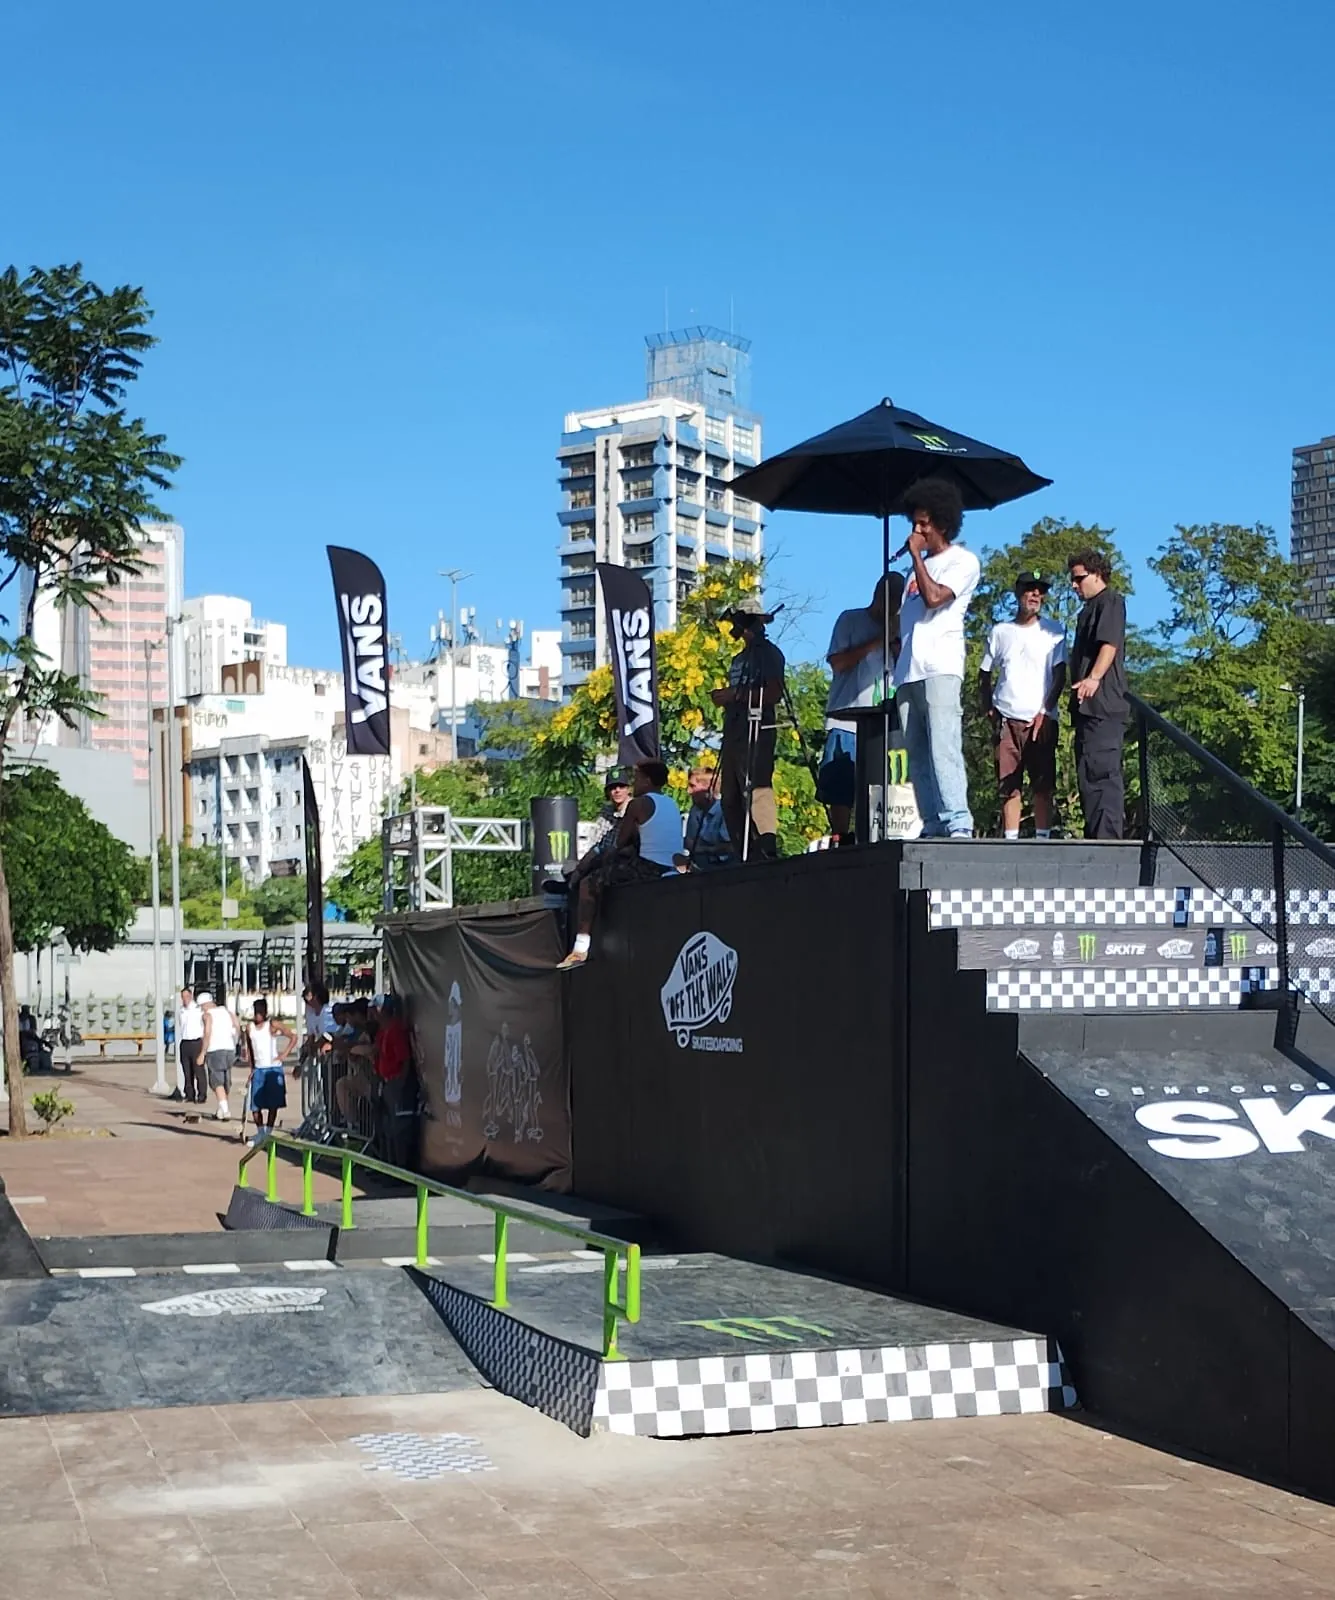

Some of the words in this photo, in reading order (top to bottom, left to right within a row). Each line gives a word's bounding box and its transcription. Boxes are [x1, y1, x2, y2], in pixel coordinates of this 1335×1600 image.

[341, 593, 387, 723] VANS
[612, 608, 654, 736] VANS
[681, 935, 709, 983] VANS
[685, 974, 706, 1019] THE
[1134, 1093, 1335, 1160] SK
